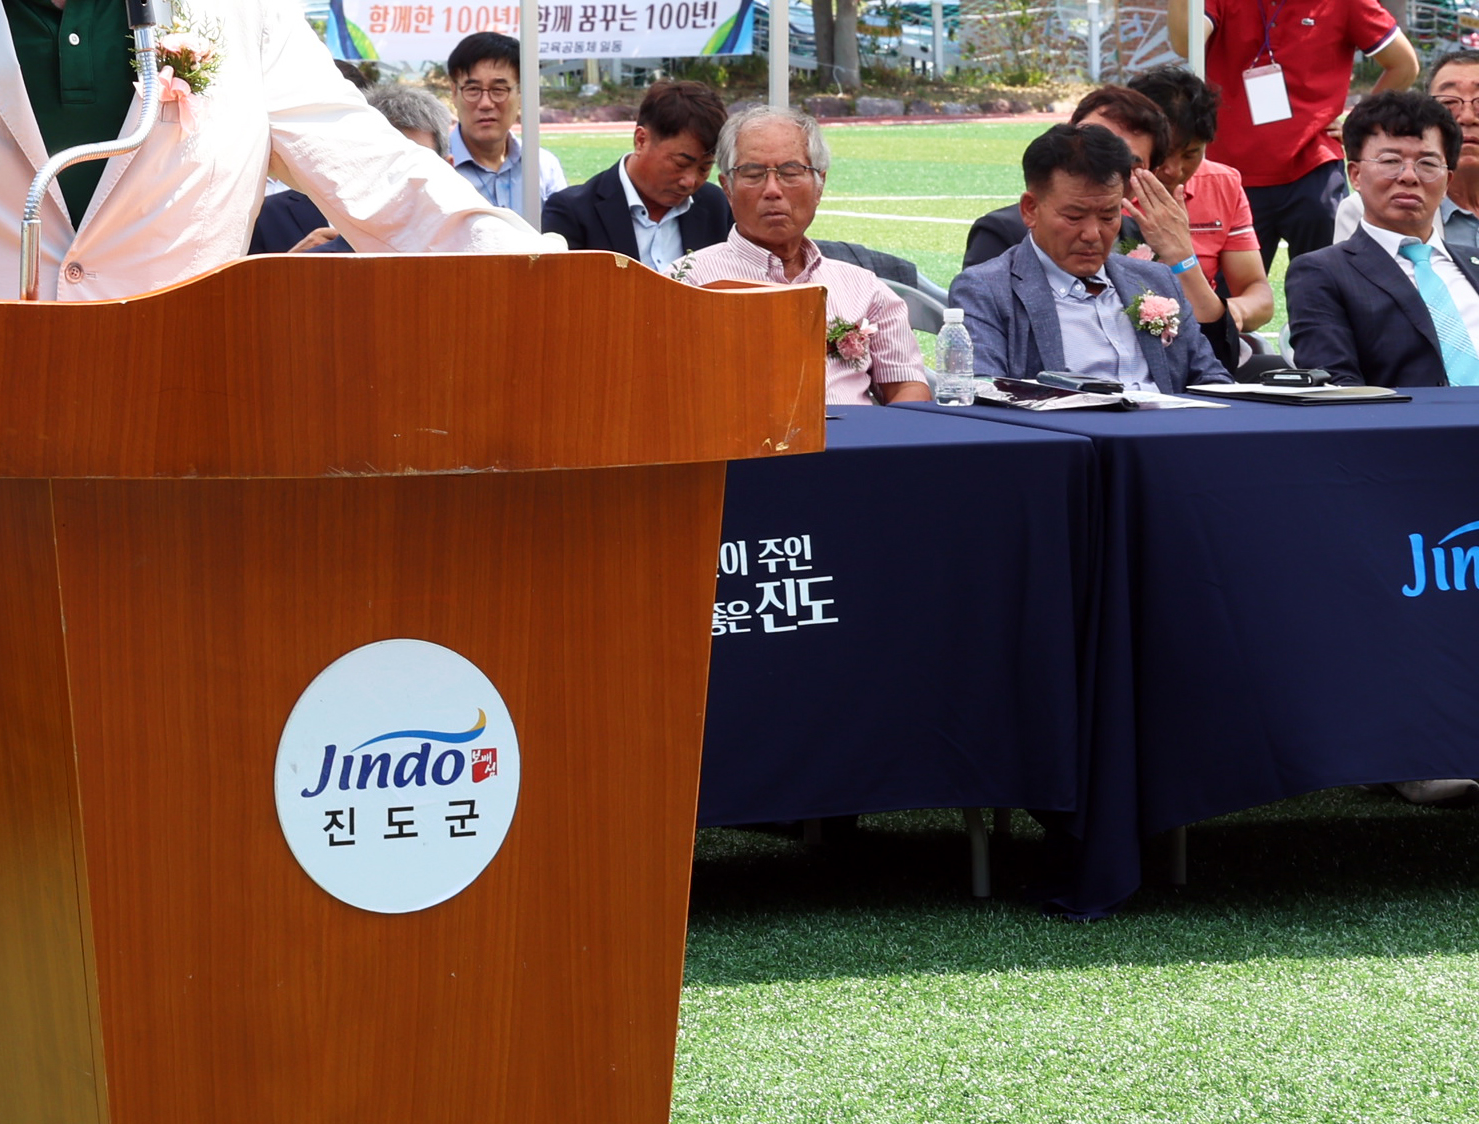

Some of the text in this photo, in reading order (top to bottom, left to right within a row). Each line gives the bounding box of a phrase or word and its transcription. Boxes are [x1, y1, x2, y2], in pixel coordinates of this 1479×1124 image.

[369, 4, 435, 34] 함께한
[578, 3, 638, 33] 꿈꾸는
[646, 0, 717, 30] 100년!
[757, 534, 813, 574] 주인
[755, 575, 839, 634] 진도
[301, 742, 465, 798] Jindo
